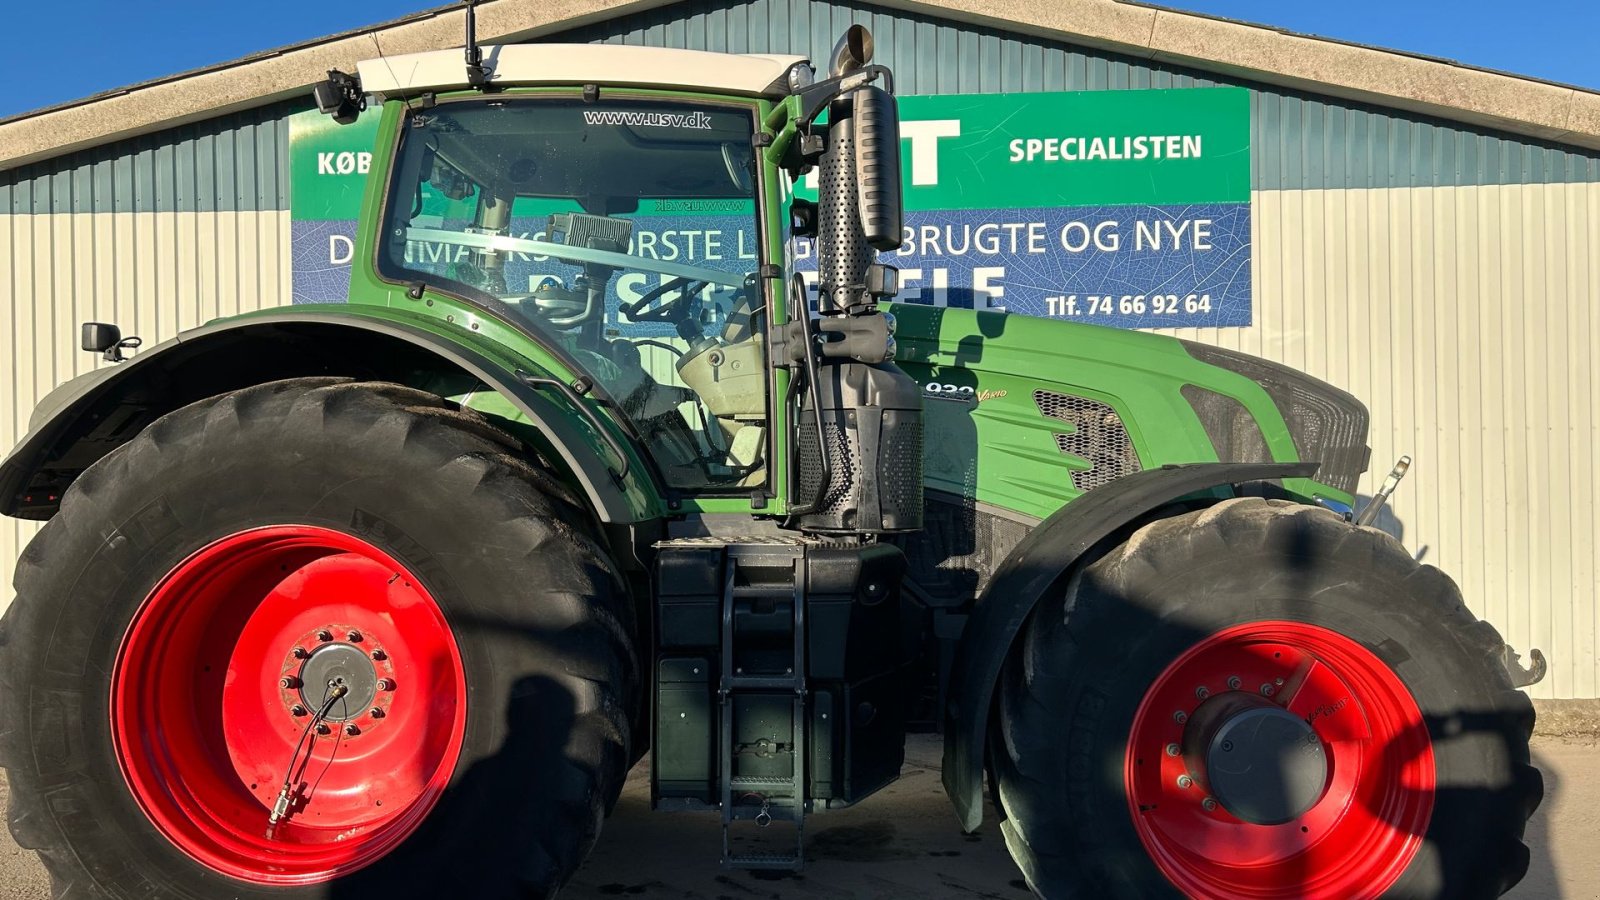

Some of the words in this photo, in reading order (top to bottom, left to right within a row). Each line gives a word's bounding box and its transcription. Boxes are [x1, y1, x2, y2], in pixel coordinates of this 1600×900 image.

[583, 111, 712, 129] www.usv.dk
[1009, 135, 1201, 162] SPECIALISTEN
[318, 151, 372, 175] KØB
[896, 222, 1047, 256] BRUGTE
[1061, 220, 1119, 252] OG
[1136, 219, 1212, 251] NYE
[1046, 296, 1081, 315] Tlf.
[1087, 296, 1113, 315] 74
[1119, 296, 1146, 315] 66
[1152, 295, 1178, 314] 92
[1185, 294, 1212, 313] 64
